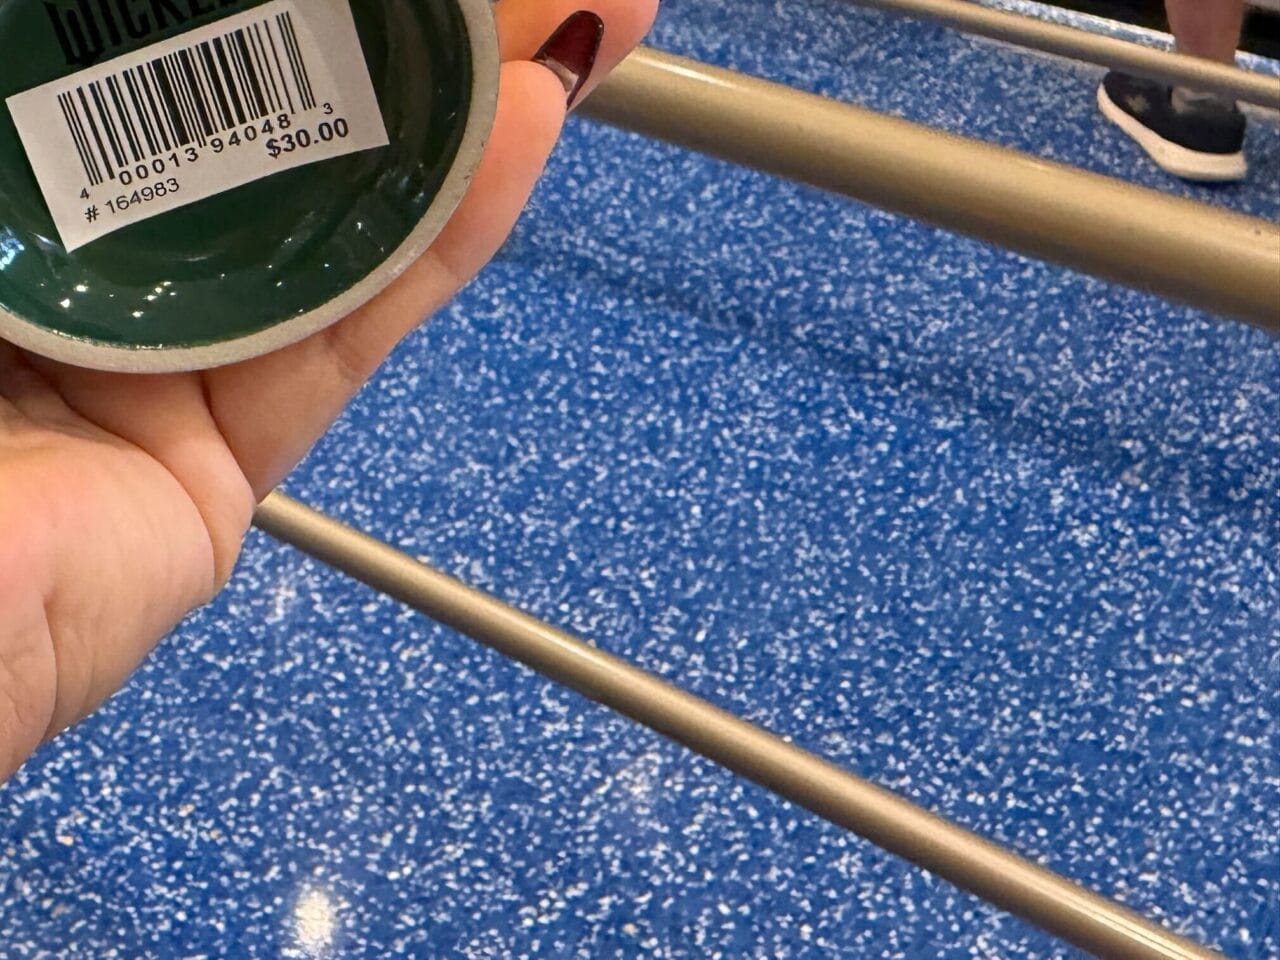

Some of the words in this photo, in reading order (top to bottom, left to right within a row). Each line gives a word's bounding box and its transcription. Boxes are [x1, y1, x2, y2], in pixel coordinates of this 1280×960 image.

[80, 187, 90, 200] 4
[118, 147, 199, 186] 00013
[210, 113, 291, 153] 94048
[322, 102, 334, 115] 3
[265, 117, 349, 159] $30.00
[84, 204, 100, 223] #
[104, 177, 180, 214] 164983
